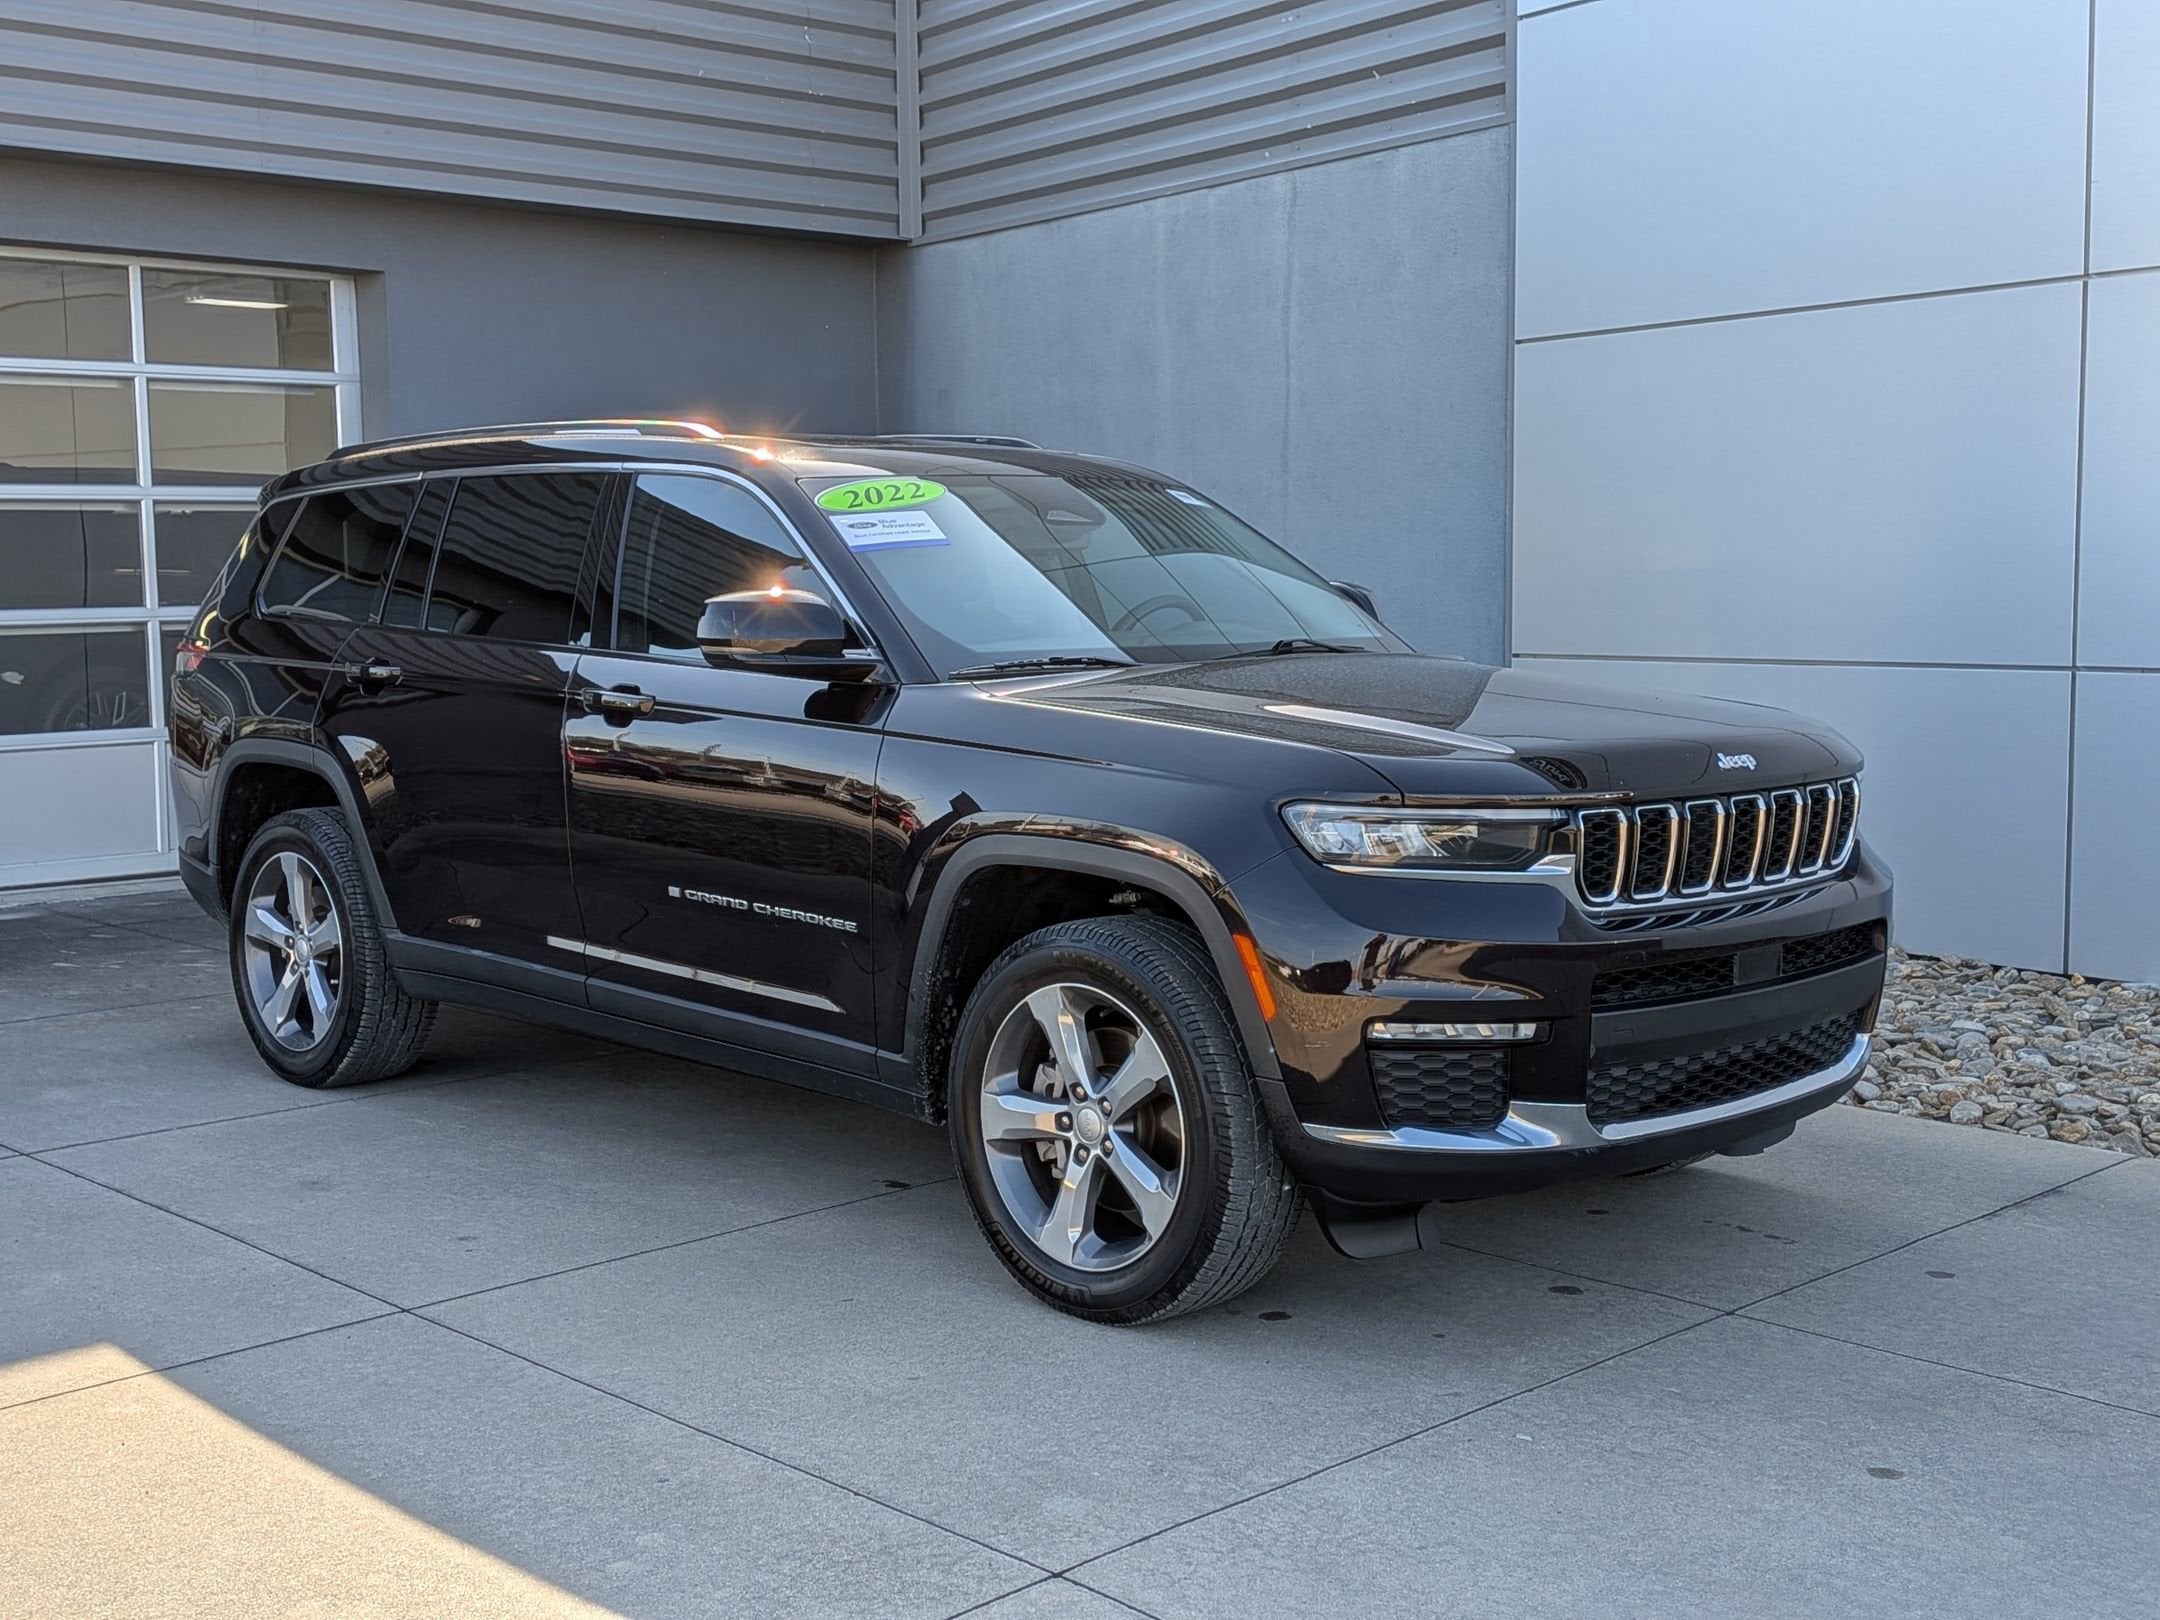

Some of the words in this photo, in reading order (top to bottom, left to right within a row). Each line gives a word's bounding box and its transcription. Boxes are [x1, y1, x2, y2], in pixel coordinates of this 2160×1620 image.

[843, 482, 925, 509] 2022
[882, 522, 925, 530] Advantage
[1717, 752, 1757, 770] Jeep
[684, 889, 749, 910] GRAND
[752, 902, 858, 933] CHEROKEE
[995, 1233, 1065, 1296] MICHELIN
